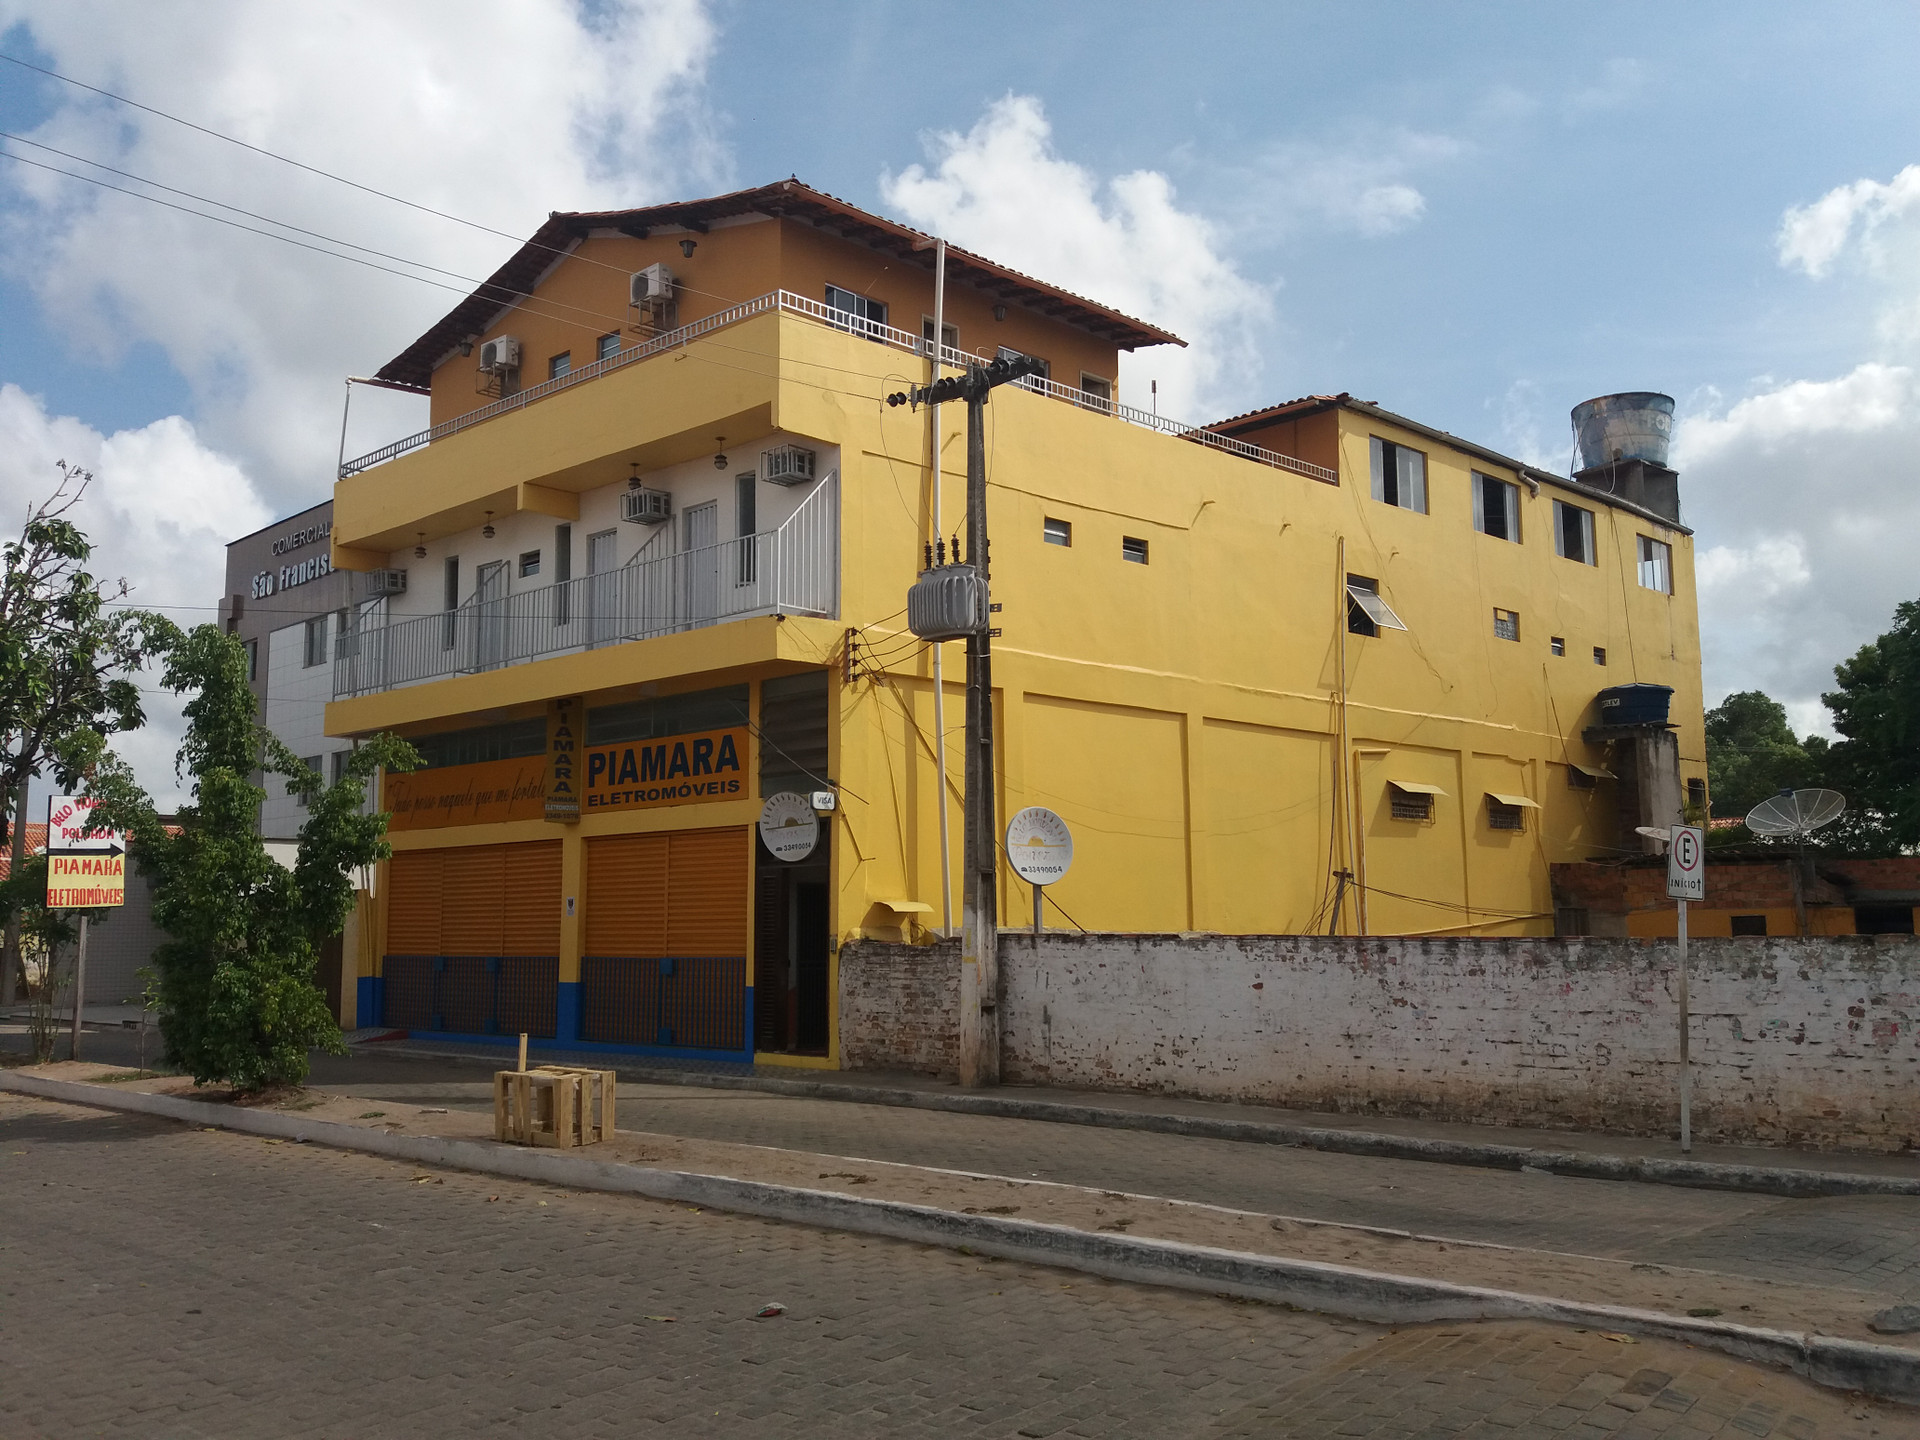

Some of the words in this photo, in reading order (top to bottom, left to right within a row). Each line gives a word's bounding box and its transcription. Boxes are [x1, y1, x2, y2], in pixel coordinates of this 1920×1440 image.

[271, 521, 331, 556] COMERCIAL
[251, 570, 274, 600] São
[588, 734, 740, 788] PIAMARA
[495, 788, 510, 801] me
[587, 780, 740, 807] ELETROMÓVEIS
[817, 796, 833, 805] VISA
[50, 804, 73, 828] BELO
[1683, 837, 1691, 864] E
[54, 858, 123, 876] PIAMARA
[47, 884, 123, 907] ELETROMÓVEIS
